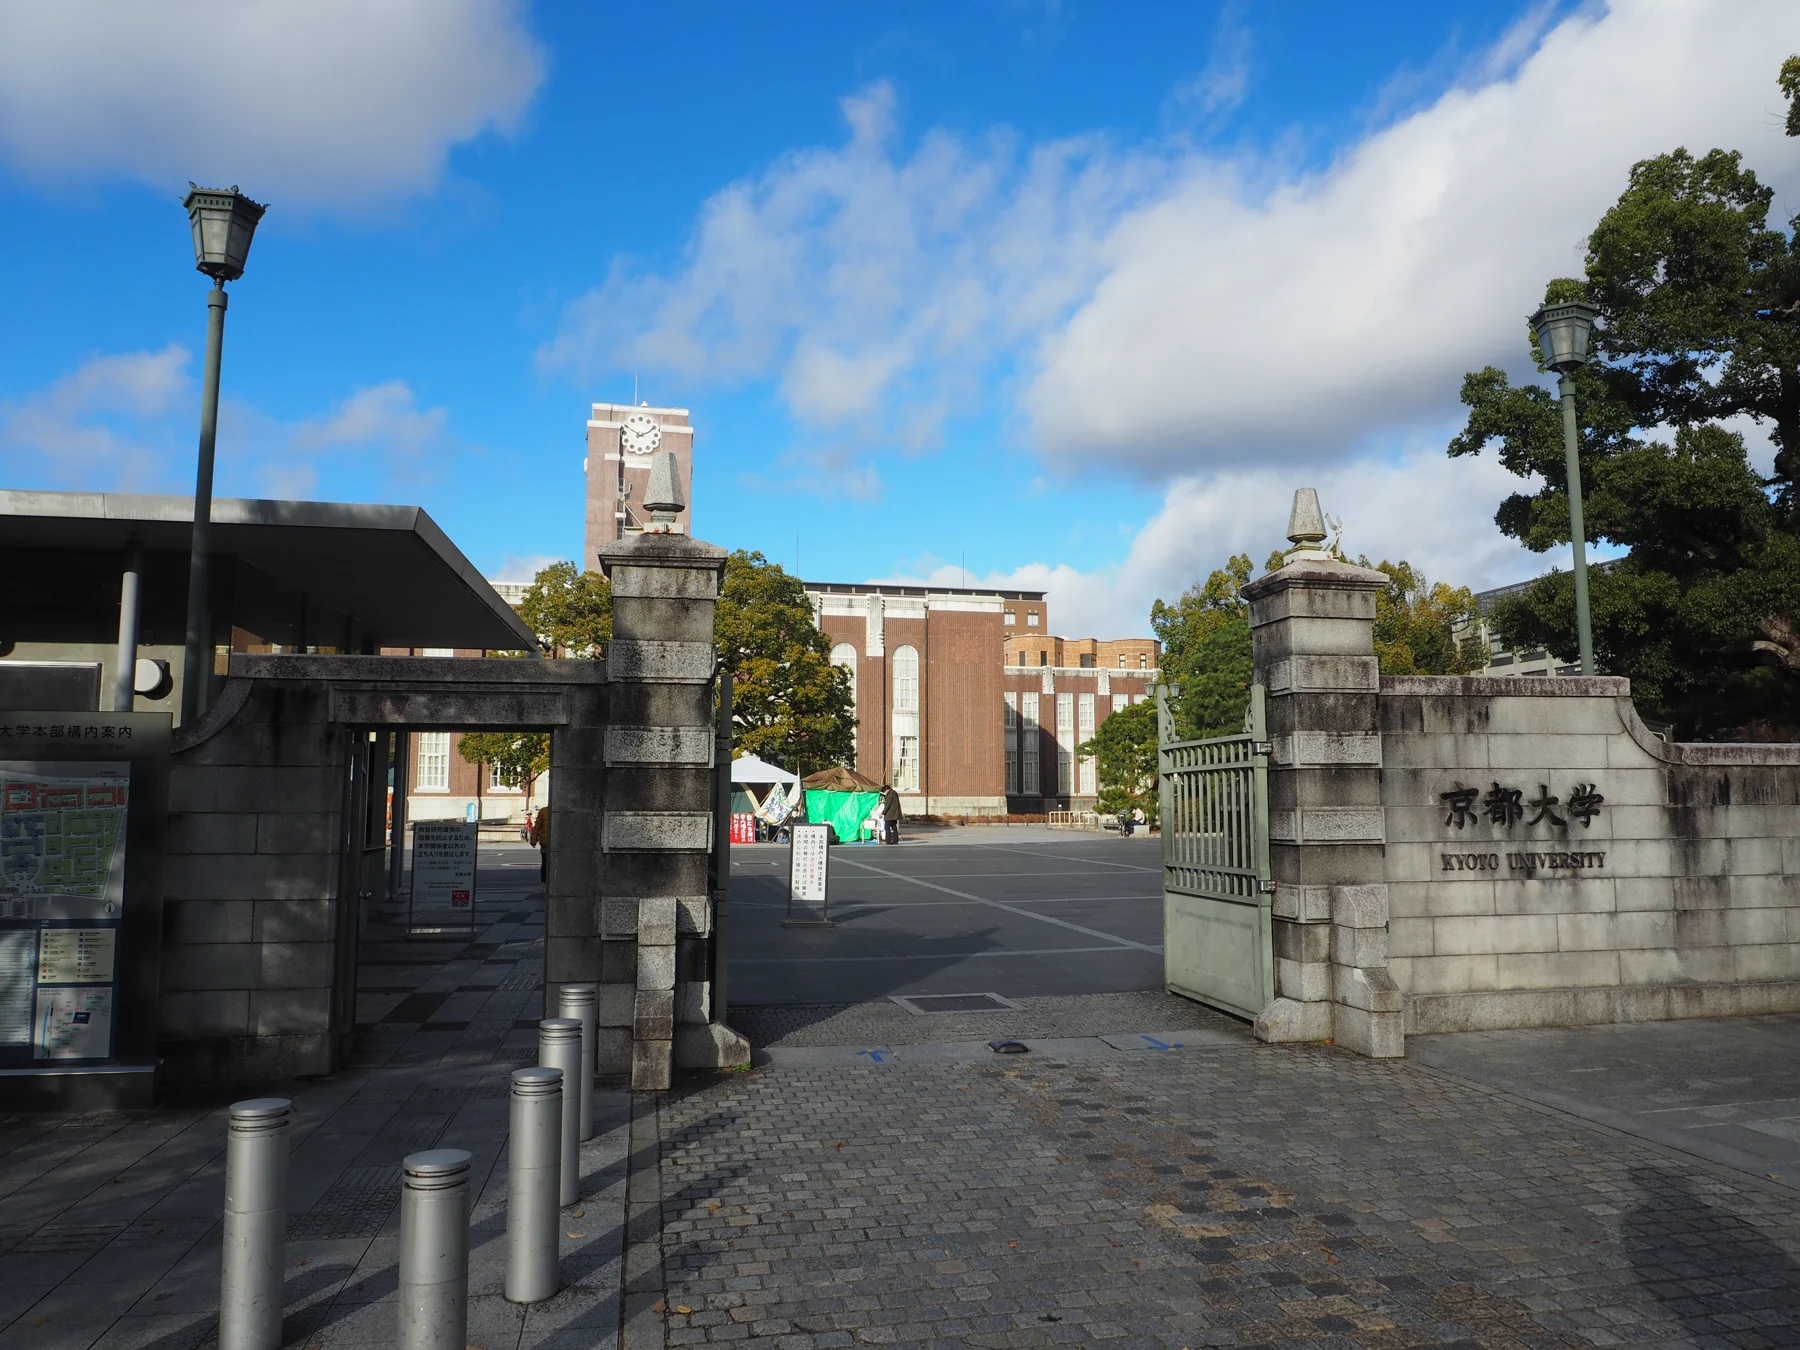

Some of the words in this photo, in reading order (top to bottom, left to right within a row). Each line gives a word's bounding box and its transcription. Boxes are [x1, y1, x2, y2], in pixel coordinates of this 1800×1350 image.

[0, 724, 132, 739] 大学本部構内案内
[1439, 781, 1605, 830] 京都大学
[1441, 852, 1499, 871] KYOTO
[1506, 851, 1606, 870] UNIVERSITY
